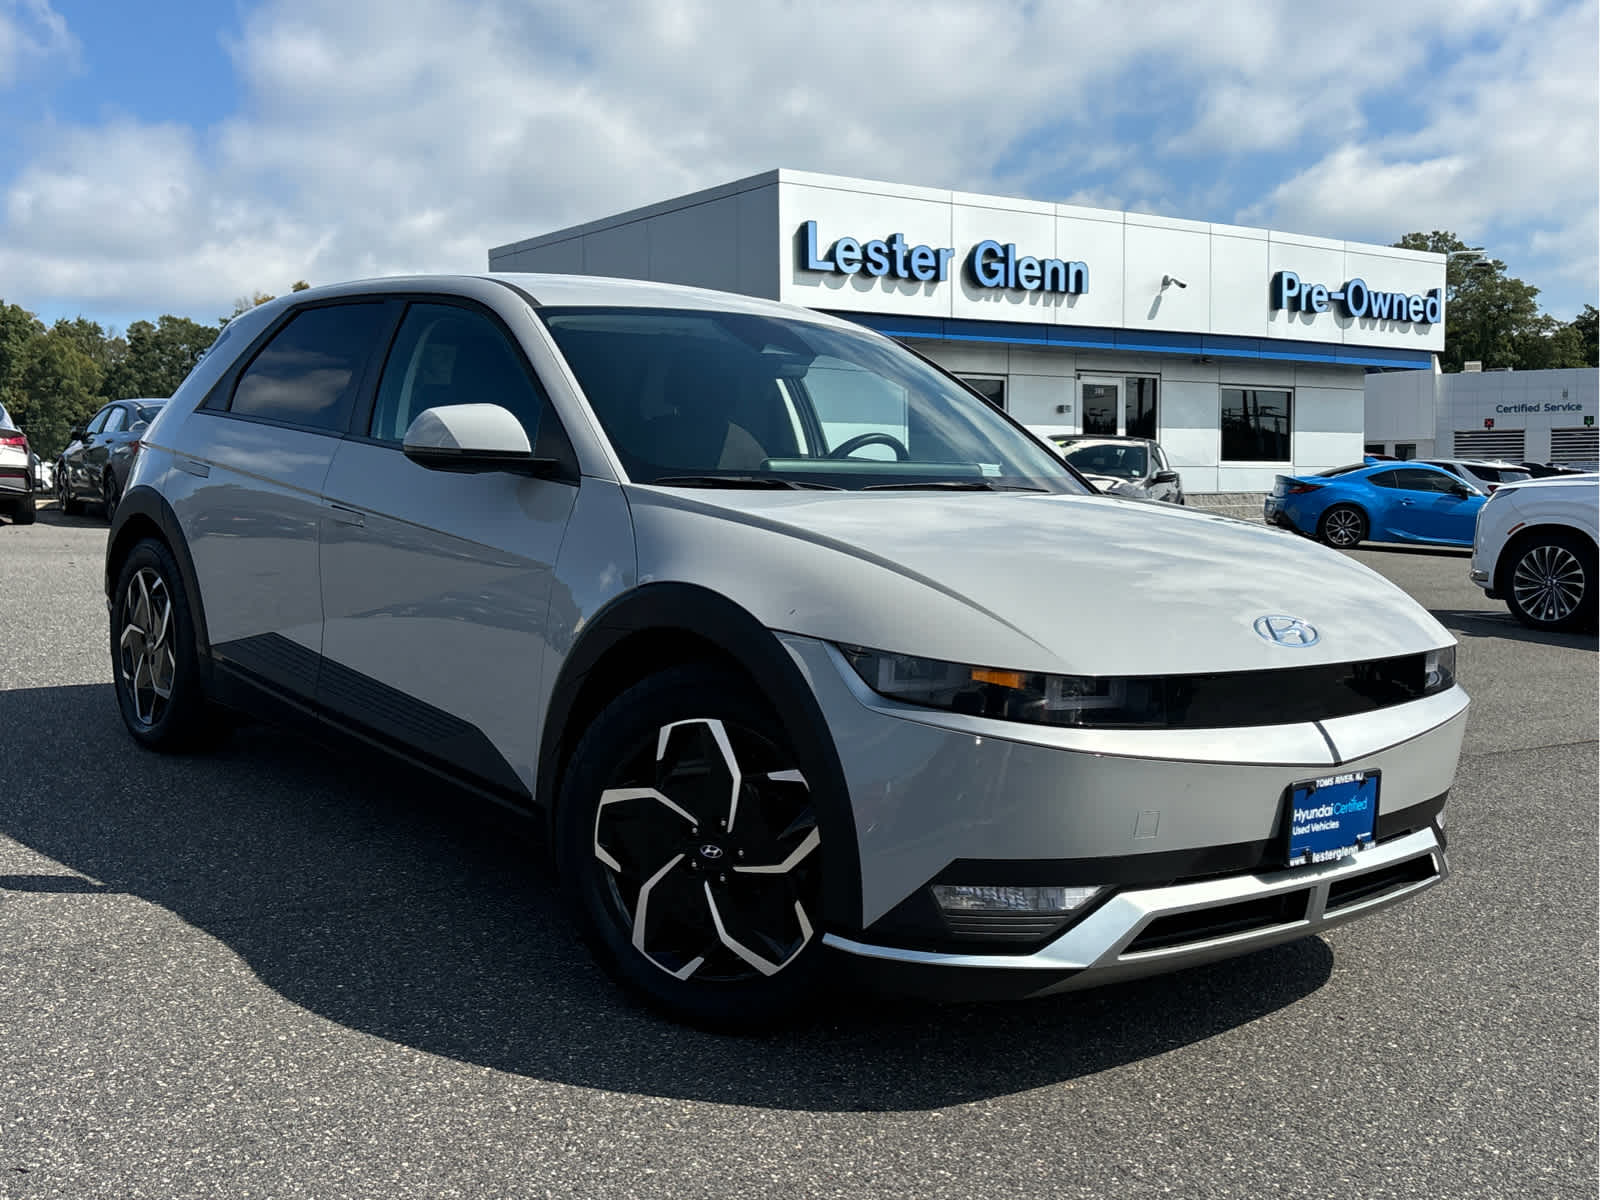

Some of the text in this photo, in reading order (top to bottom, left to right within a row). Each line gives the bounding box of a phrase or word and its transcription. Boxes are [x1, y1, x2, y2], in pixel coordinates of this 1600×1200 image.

[803, 219, 1089, 295] Lester Glenn
[1273, 270, 1442, 324] Pre-Owned
[1495, 402, 1583, 414] Certified Service
[1316, 777, 1334, 788] TOMS
[1292, 820, 1340, 836] Used Vehicles
[1312, 844, 1359, 864] lesterglenn
